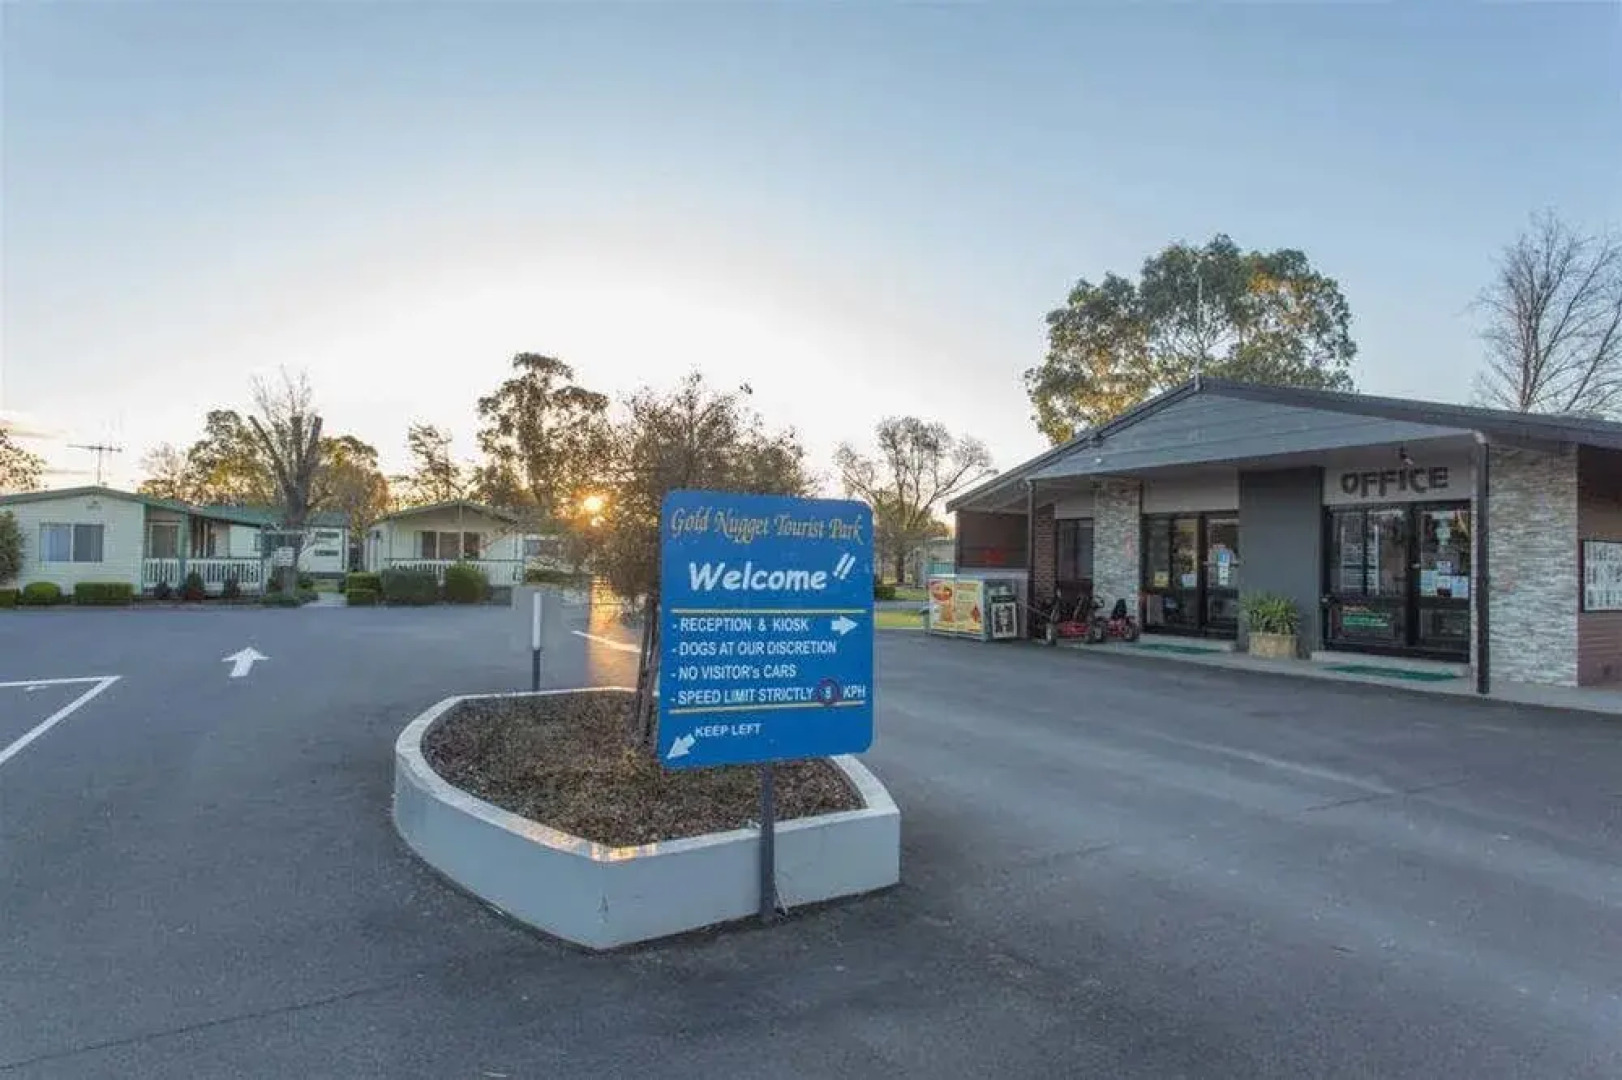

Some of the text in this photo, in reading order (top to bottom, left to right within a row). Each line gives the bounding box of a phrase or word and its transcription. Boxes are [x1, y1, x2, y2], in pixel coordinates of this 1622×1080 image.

[1341, 466, 1449, 498] OFFICE
[714, 509, 769, 544] Nugget
[774, 514, 824, 538] Tourist
[828, 514, 864, 545] Park
[680, 617, 809, 632] RECEPTION & KIOSK
[679, 640, 837, 656] DOGS AT OUR DISCRETION
[679, 666, 698, 680] NO
[763, 664, 797, 678] CARS
[678, 688, 721, 704] SPEED
[724, 688, 755, 703] LIMIT
[758, 687, 814, 702] STRICTLY
[843, 684, 866, 699] KPH
[695, 722, 762, 737] KEEP LEFT
